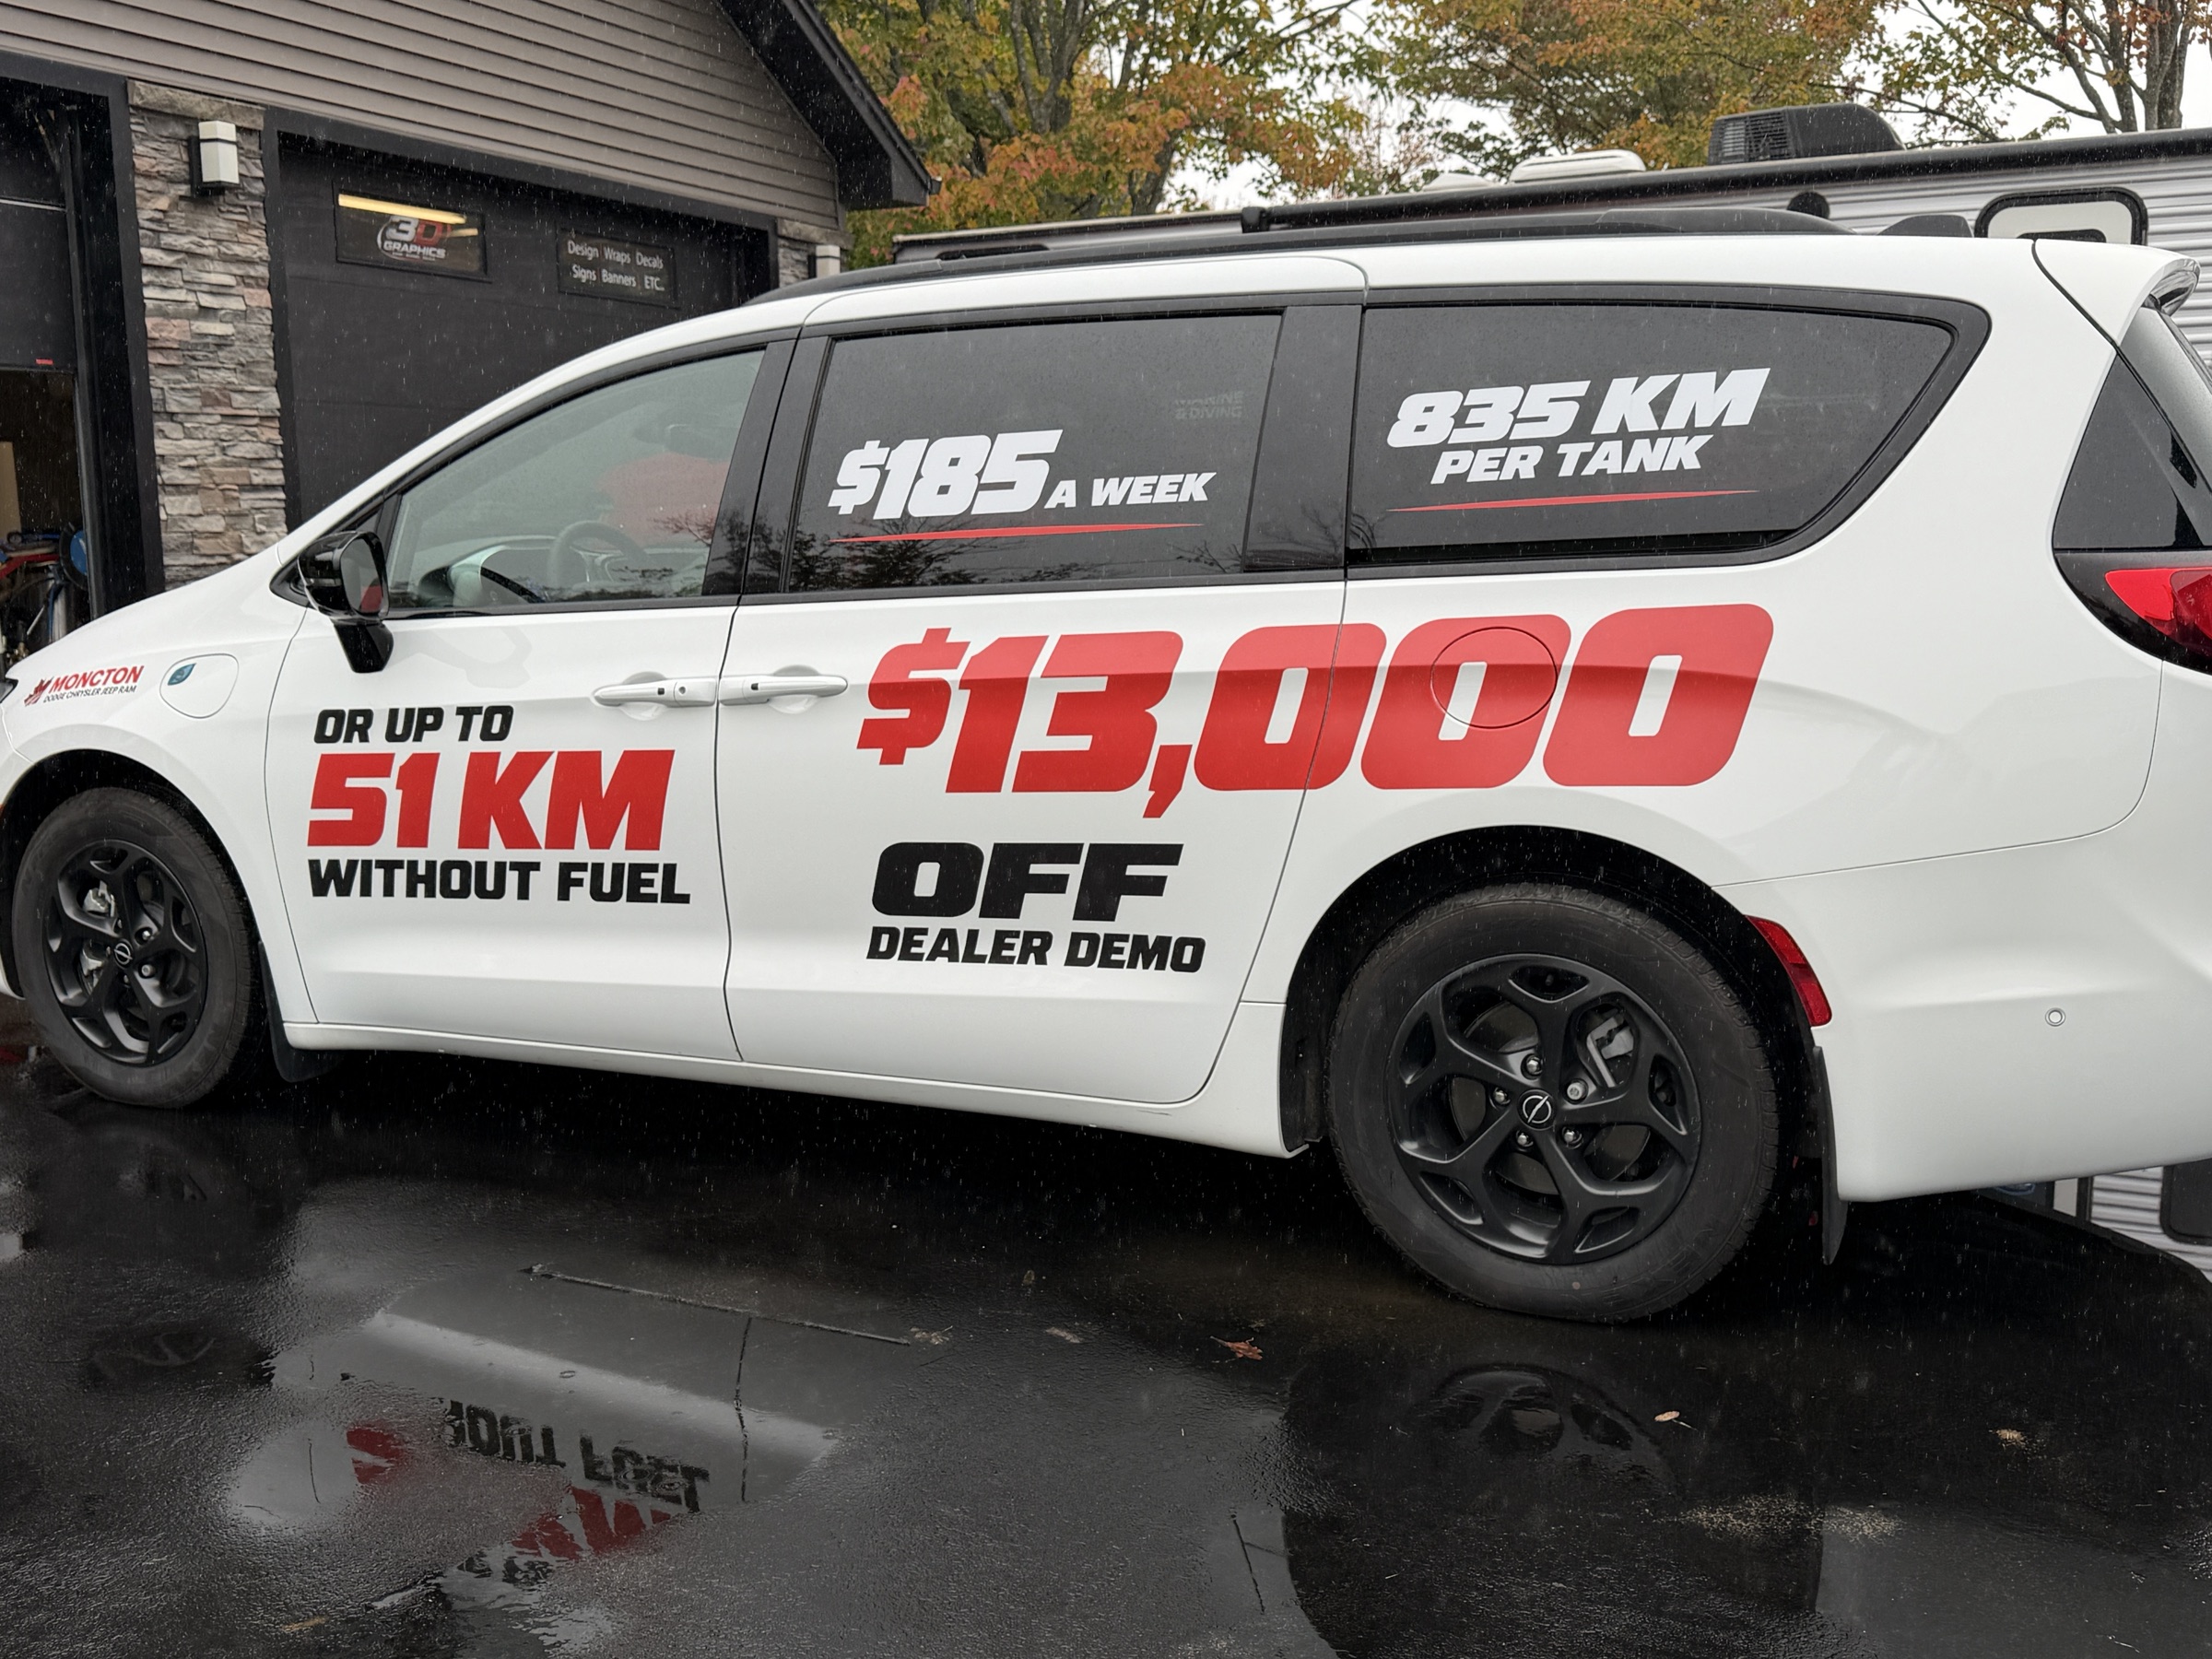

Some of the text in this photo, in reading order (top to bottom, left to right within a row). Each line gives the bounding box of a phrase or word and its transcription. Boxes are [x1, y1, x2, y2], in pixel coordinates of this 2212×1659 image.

[383, 240, 446, 259] GRAPHICS
[567, 240, 665, 270] Design Wraps Decals
[572, 264, 597, 283] Signs
[601, 268, 637, 288] Banners
[1386, 367, 1771, 448] 835 KM
[826, 429, 1218, 520] $185 A WEEK
[1430, 434, 1714, 485] PER TANK
[49, 665, 145, 693] MONCTON
[65, 688, 101, 700] CHRYSLER
[100, 685, 120, 696] JEEP
[118, 685, 137, 694] RAM
[313, 705, 514, 744] OR UP TO
[856, 603, 1774, 818] $13,000
[307, 749, 676, 851] 51 KM
[308, 859, 691, 904] WITHOUT FUEL
[871, 841, 1184, 923] OFF
[865, 925, 1206, 973] DEALER DEMO
